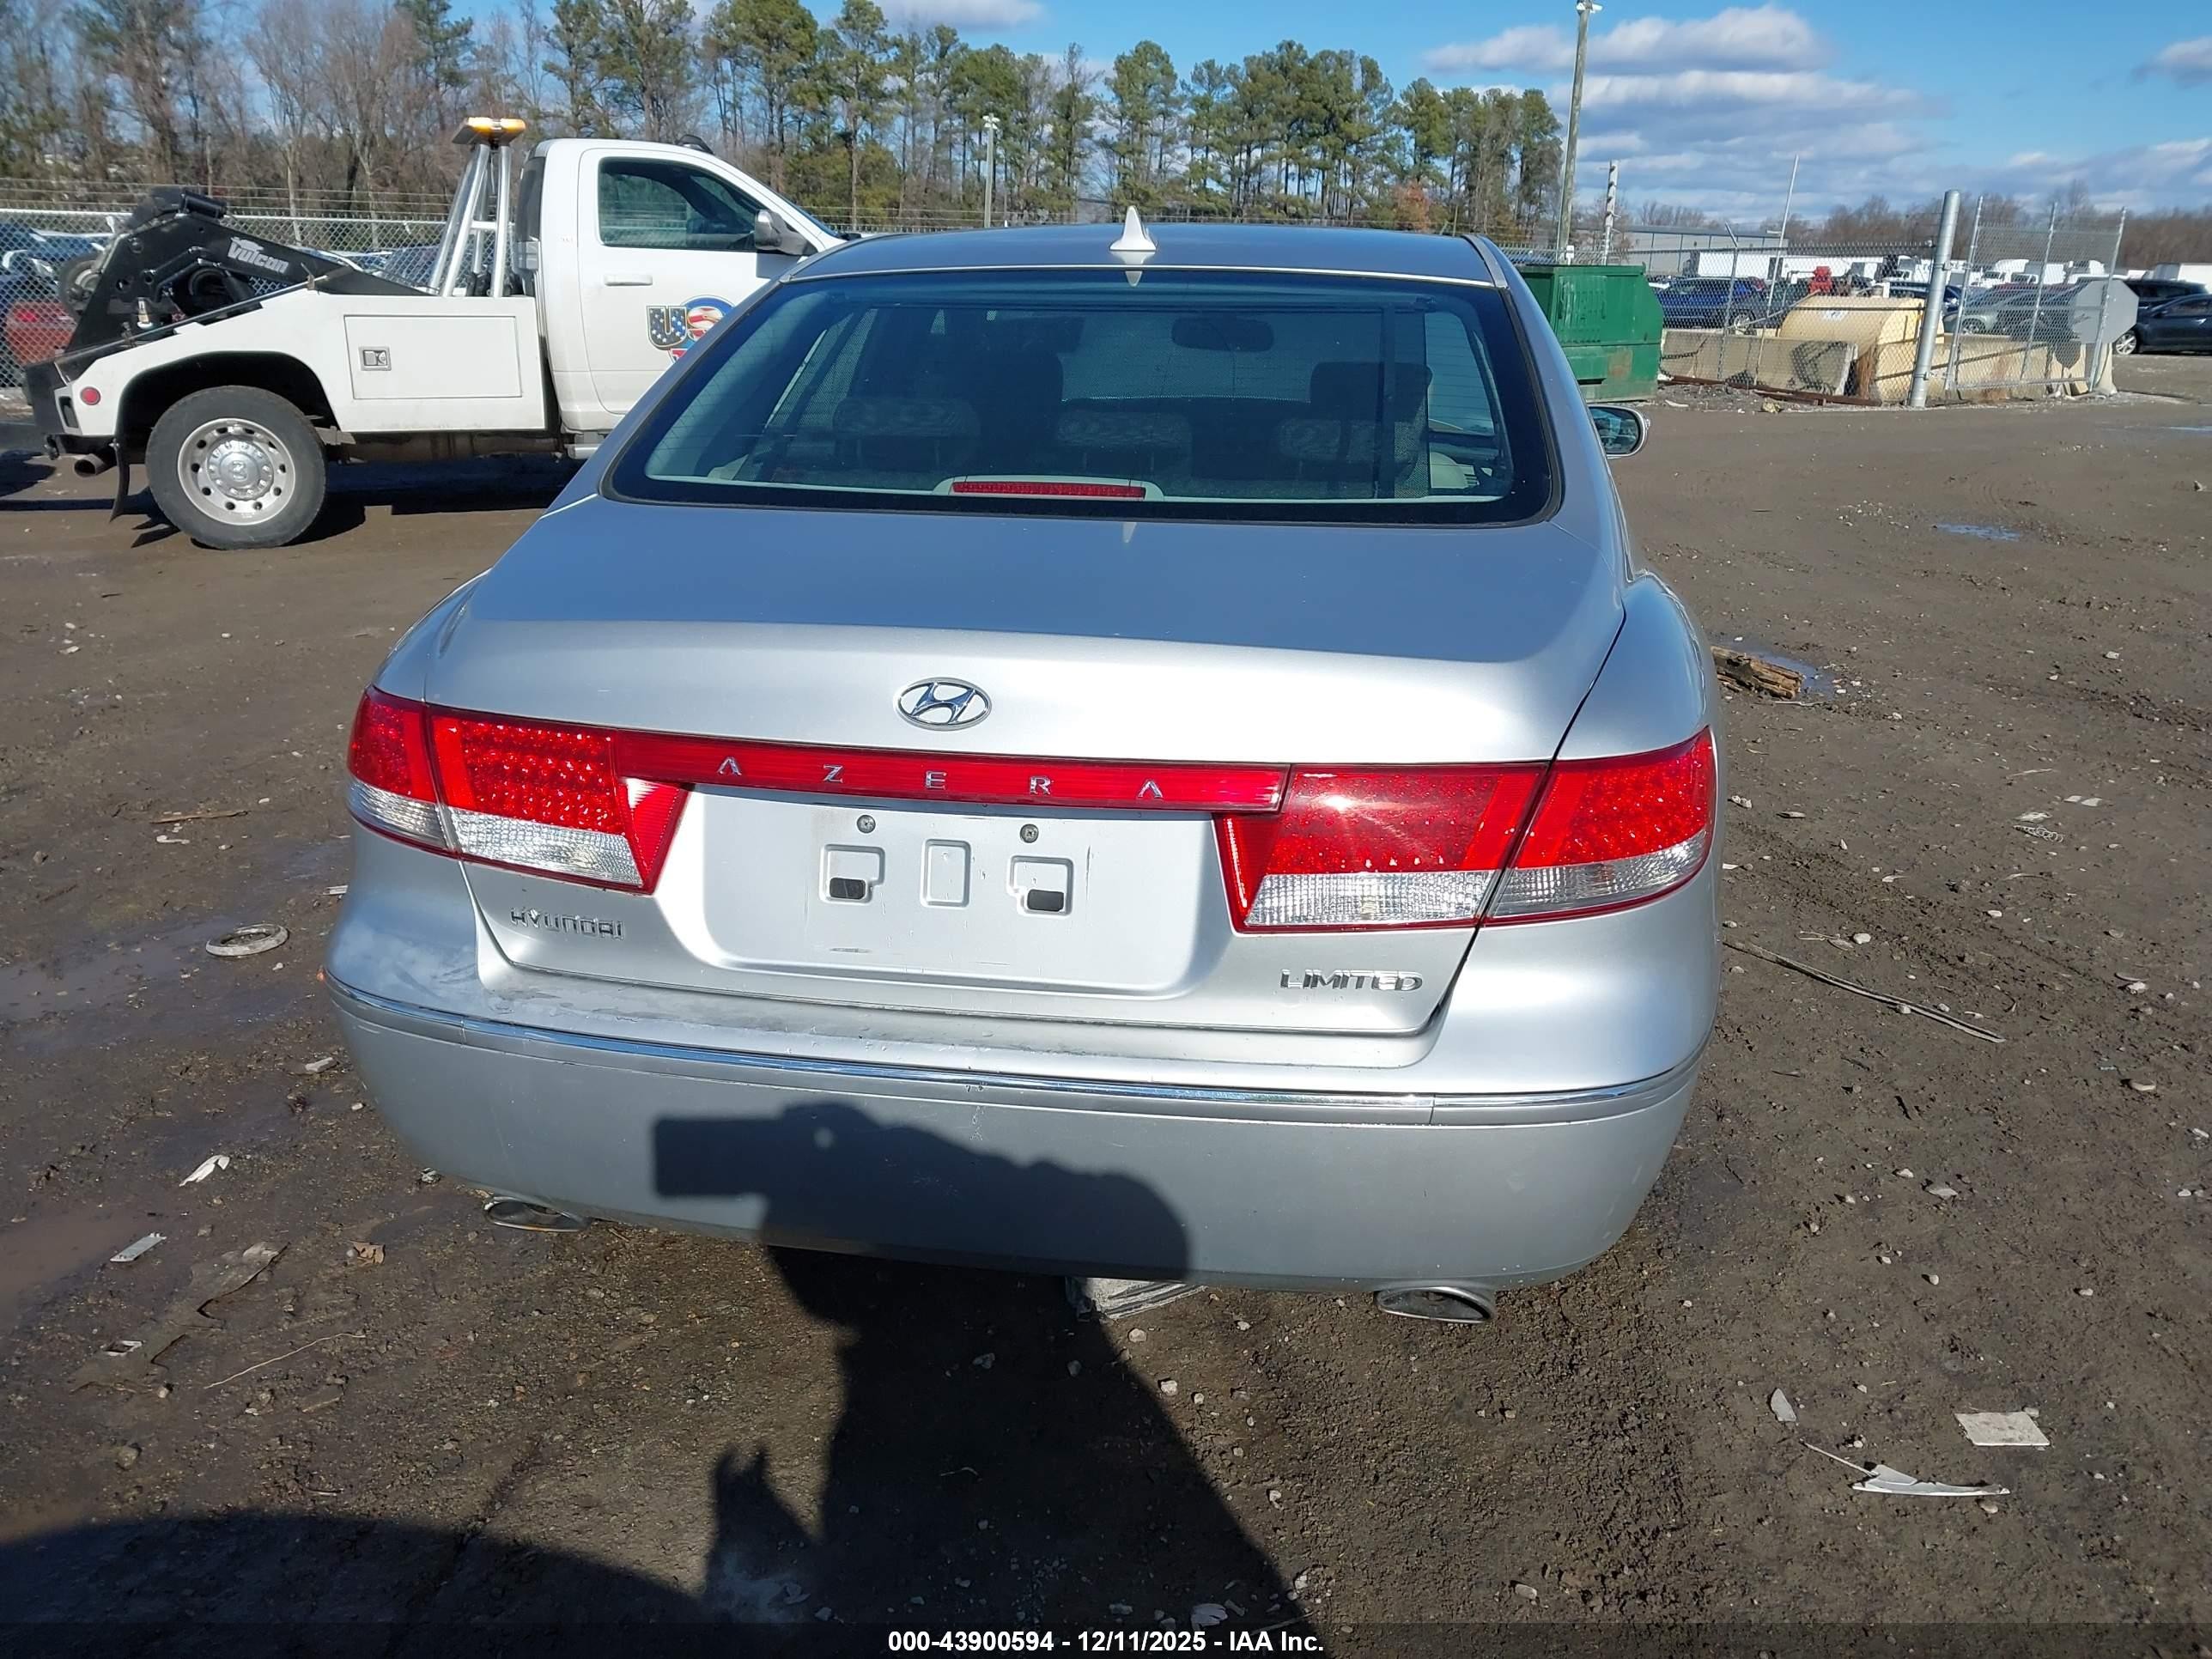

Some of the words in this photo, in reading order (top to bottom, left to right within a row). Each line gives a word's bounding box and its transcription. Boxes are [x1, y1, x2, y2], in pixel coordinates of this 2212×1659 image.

[717, 756, 1164, 799] AZERA
[509, 907, 624, 941] HYUNDAI
[1279, 969, 1424, 992] LIMITED
